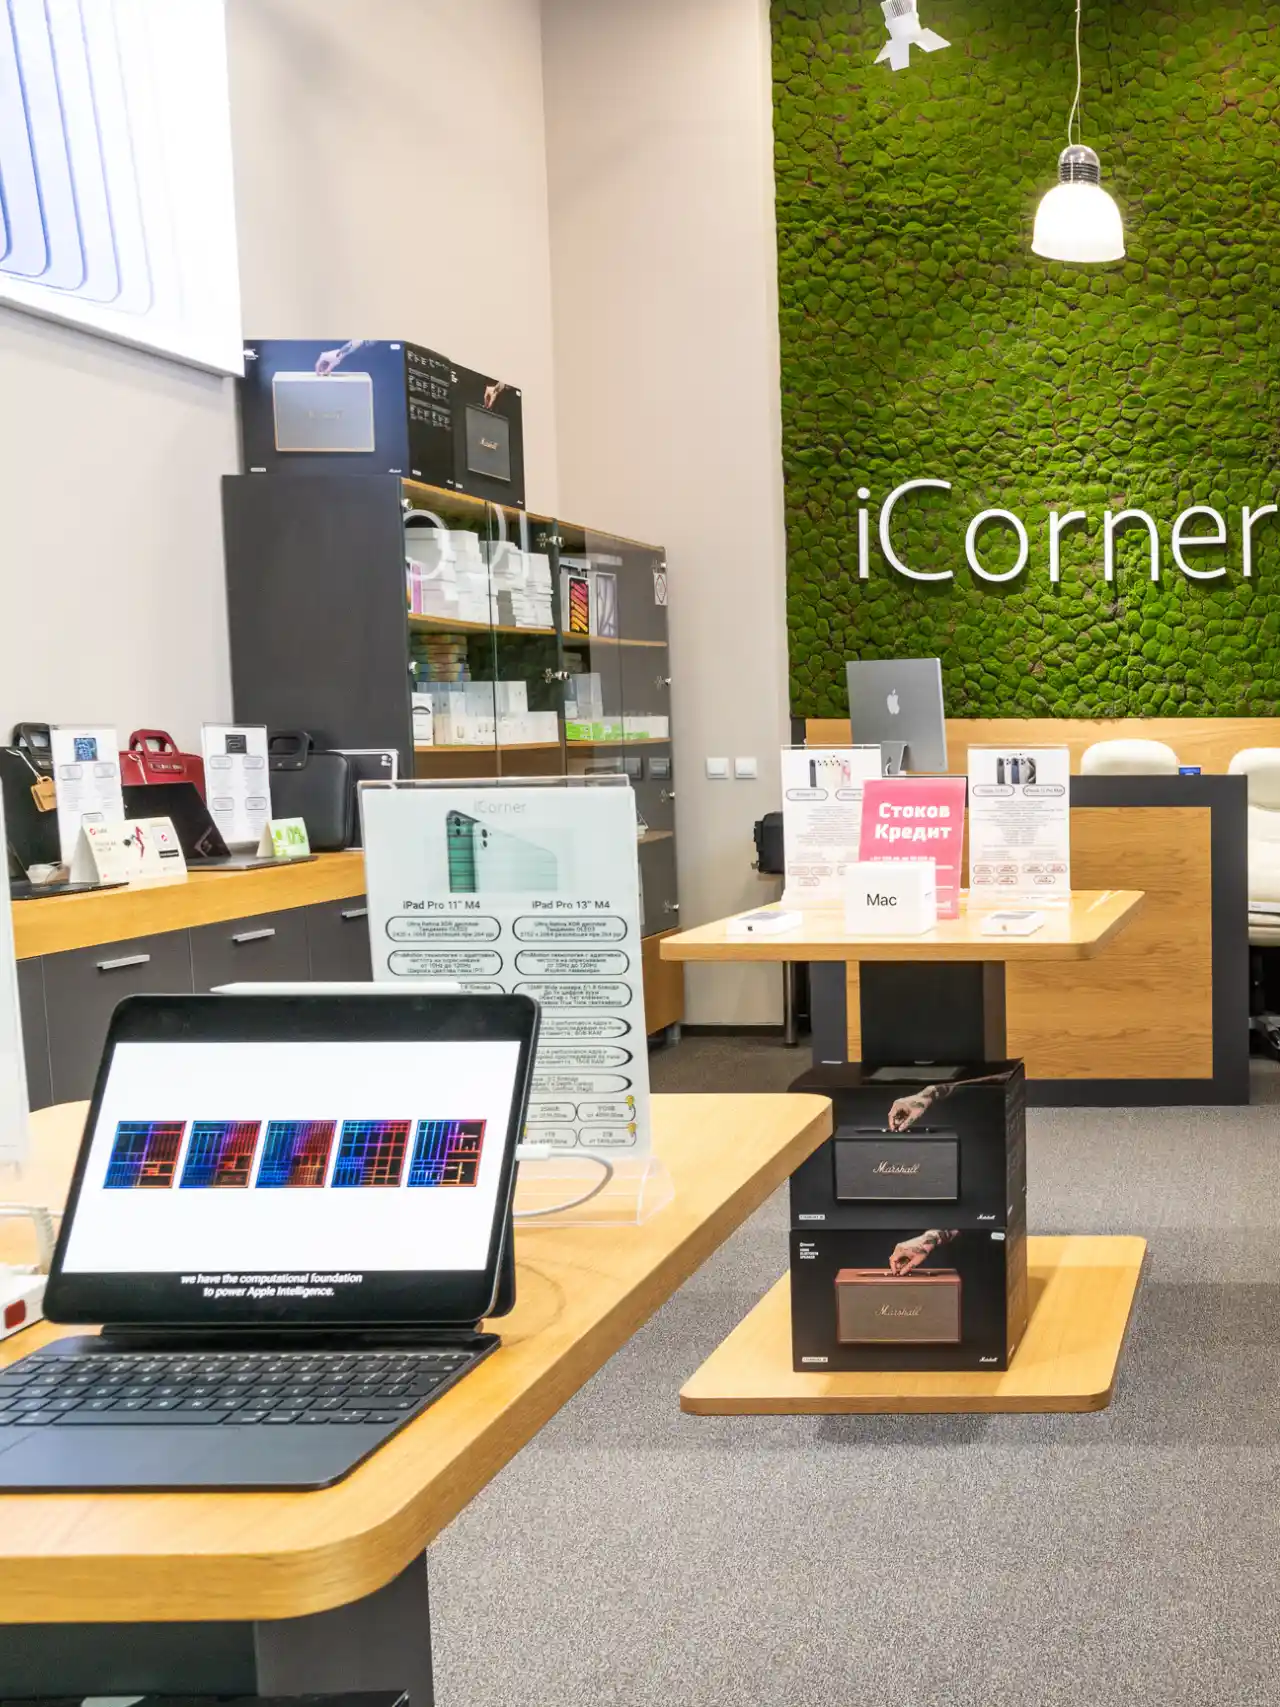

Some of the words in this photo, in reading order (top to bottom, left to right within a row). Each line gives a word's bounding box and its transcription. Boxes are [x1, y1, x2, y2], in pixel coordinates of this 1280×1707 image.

[857, 478, 1279, 583] iCorner
[473, 798, 527, 814] iCorner
[879, 802, 950, 819] Стоков
[874, 823, 952, 842] Кредит
[402, 900, 425, 910] iPad
[427, 901, 445, 910] Pro
[464, 901, 481, 910] M4
[532, 900, 553, 909] iPad
[556, 901, 573, 909] Pro
[576, 900, 592, 909] 13"
[594, 901, 610, 909] M4
[866, 894, 897, 907] Mac
[873, 1160, 920, 1174] Marshall
[180, 1275, 196, 1284] we
[197, 1273, 221, 1284] have
[221, 1273, 238, 1284] the
[239, 1273, 308, 1285] computational
[310, 1273, 363, 1284] foundation
[203, 1287, 213, 1297] to
[214, 1288, 245, 1298] power
[247, 1286, 275, 1298] Apple
[277, 1286, 335, 1298] Intelligence.
[875, 1304, 921, 1317] Marshall
